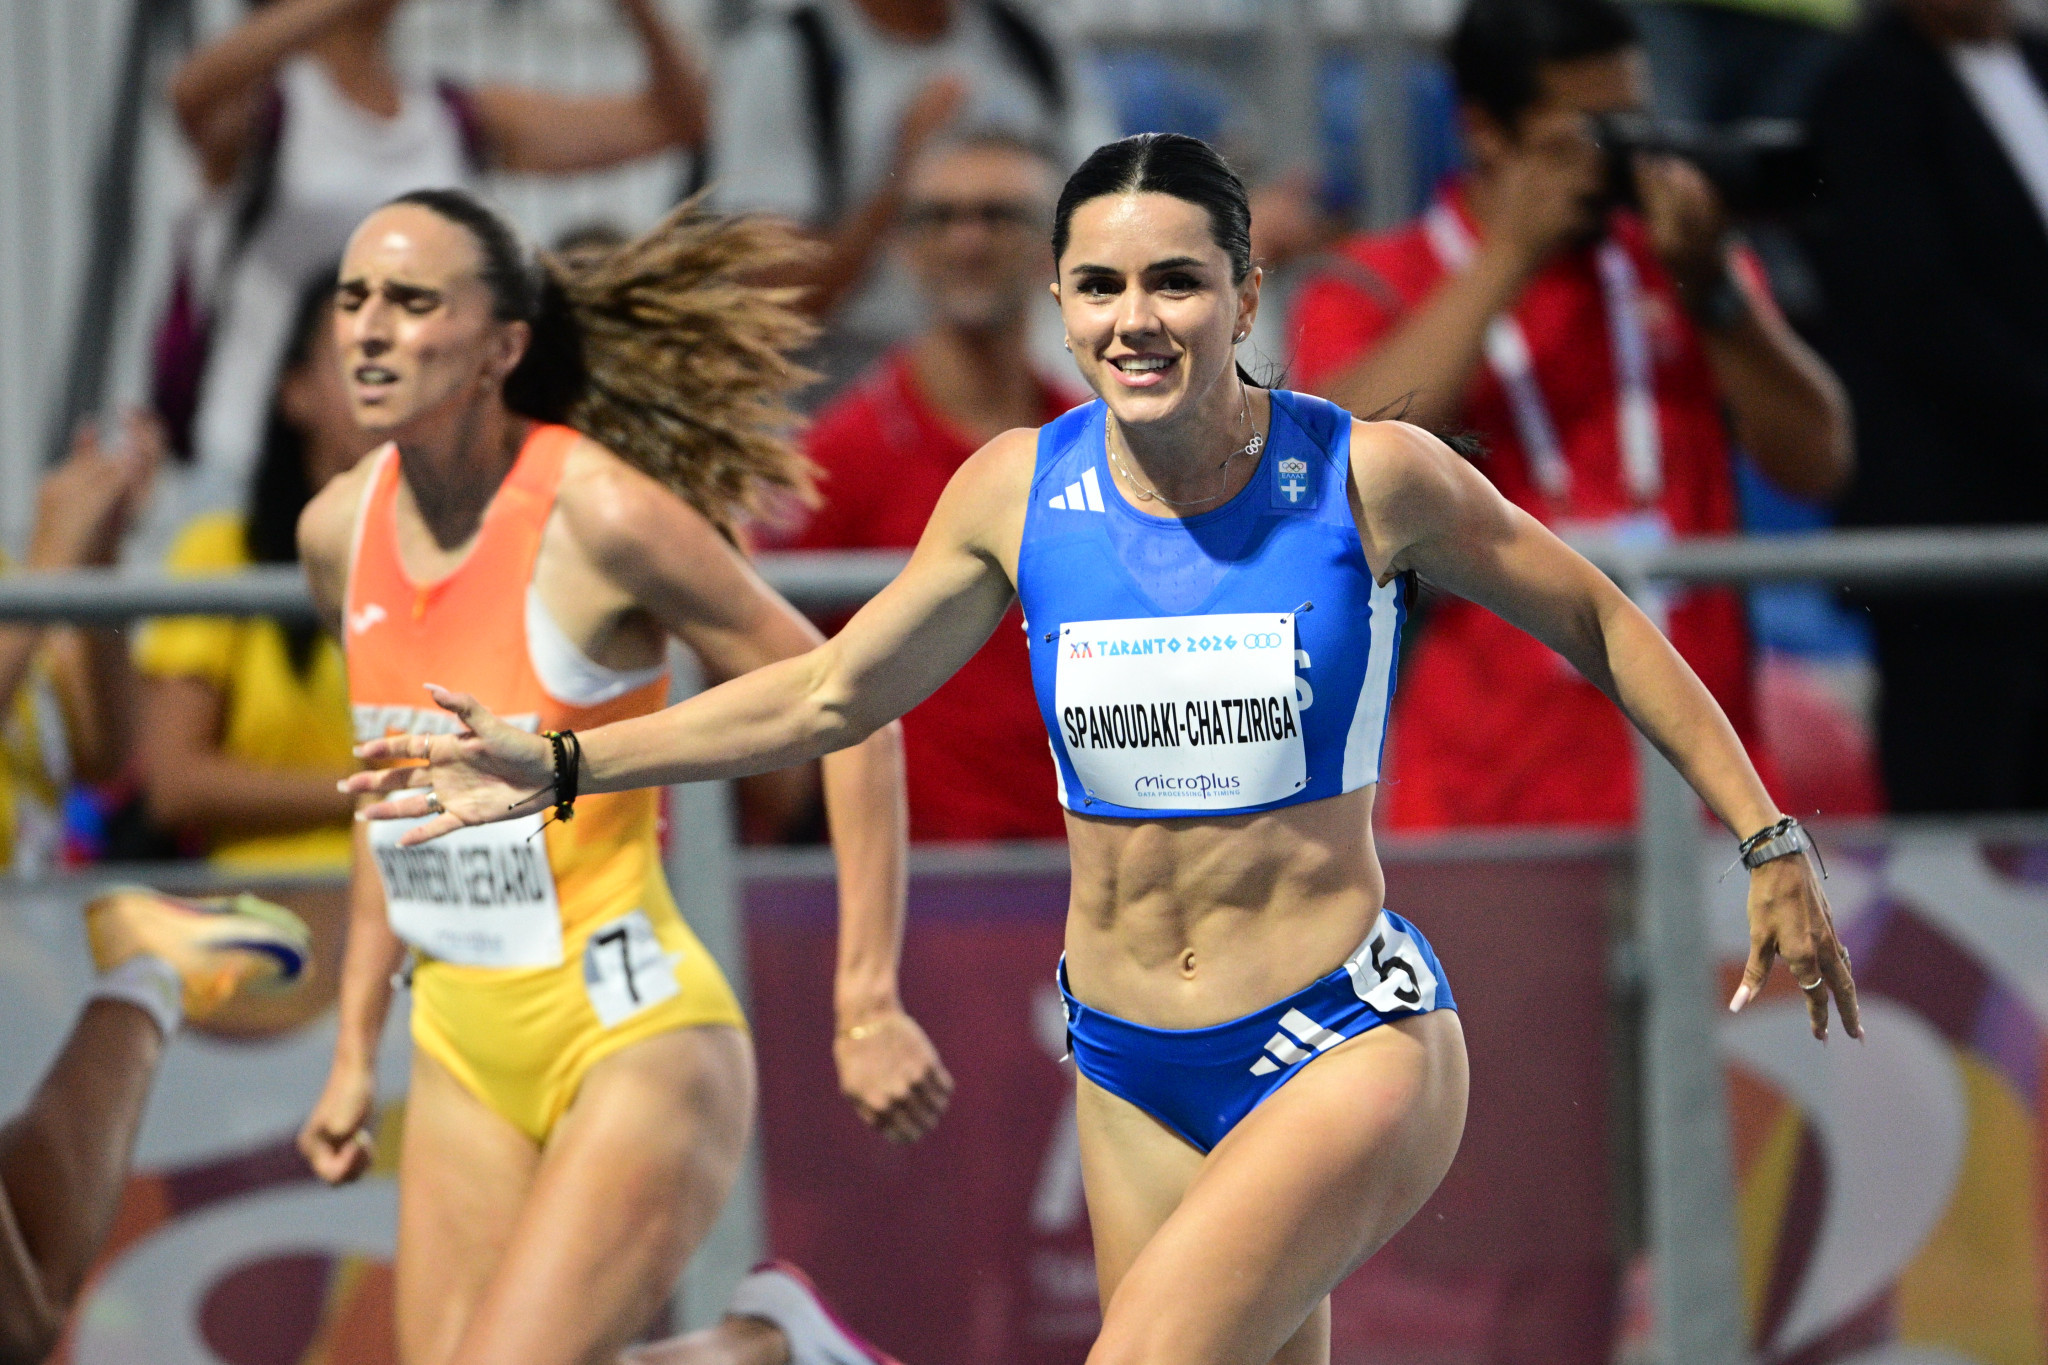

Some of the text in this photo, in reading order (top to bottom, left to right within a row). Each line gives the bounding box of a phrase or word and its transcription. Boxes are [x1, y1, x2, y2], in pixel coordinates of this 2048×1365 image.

[1097, 637, 1181, 656] TARANTO
[1187, 634, 1238, 653] 2026
[1064, 696, 1297, 749] SPANOUDAKI-CHATZIRIGA
[1214, 789, 1241, 797] TIMING
[597, 929, 640, 1003] 7
[1370, 932, 1421, 1003] 5
